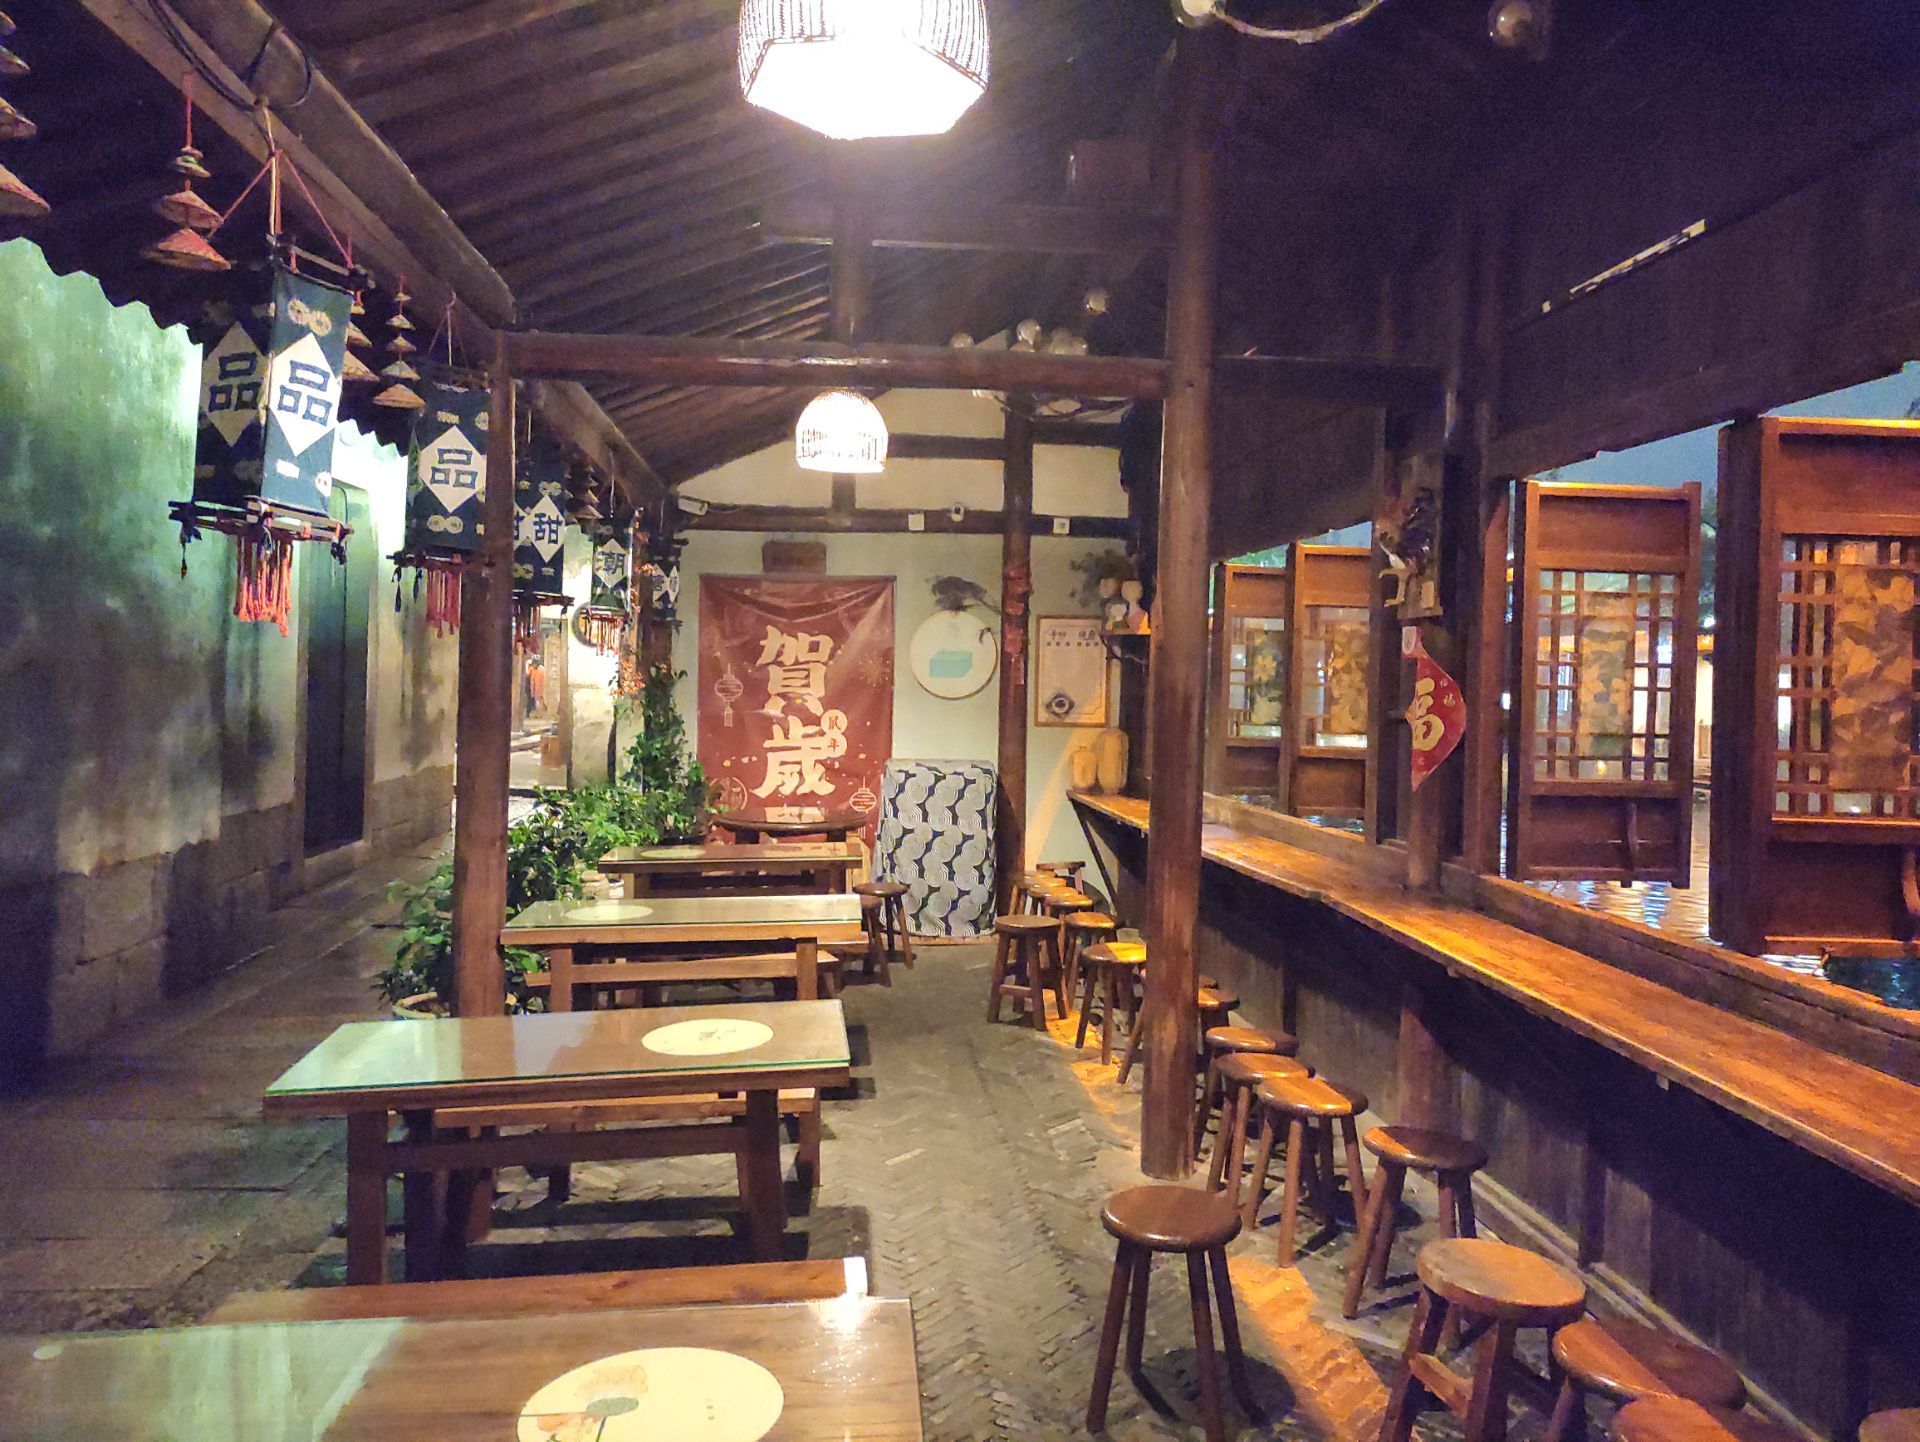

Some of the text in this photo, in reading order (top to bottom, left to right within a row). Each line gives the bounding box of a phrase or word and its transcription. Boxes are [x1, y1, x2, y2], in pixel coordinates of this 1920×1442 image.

[209, 352, 261, 413] 品
[278, 360, 333, 427] 品
[430, 448, 478, 489] 品
[533, 512, 564, 545] 甜
